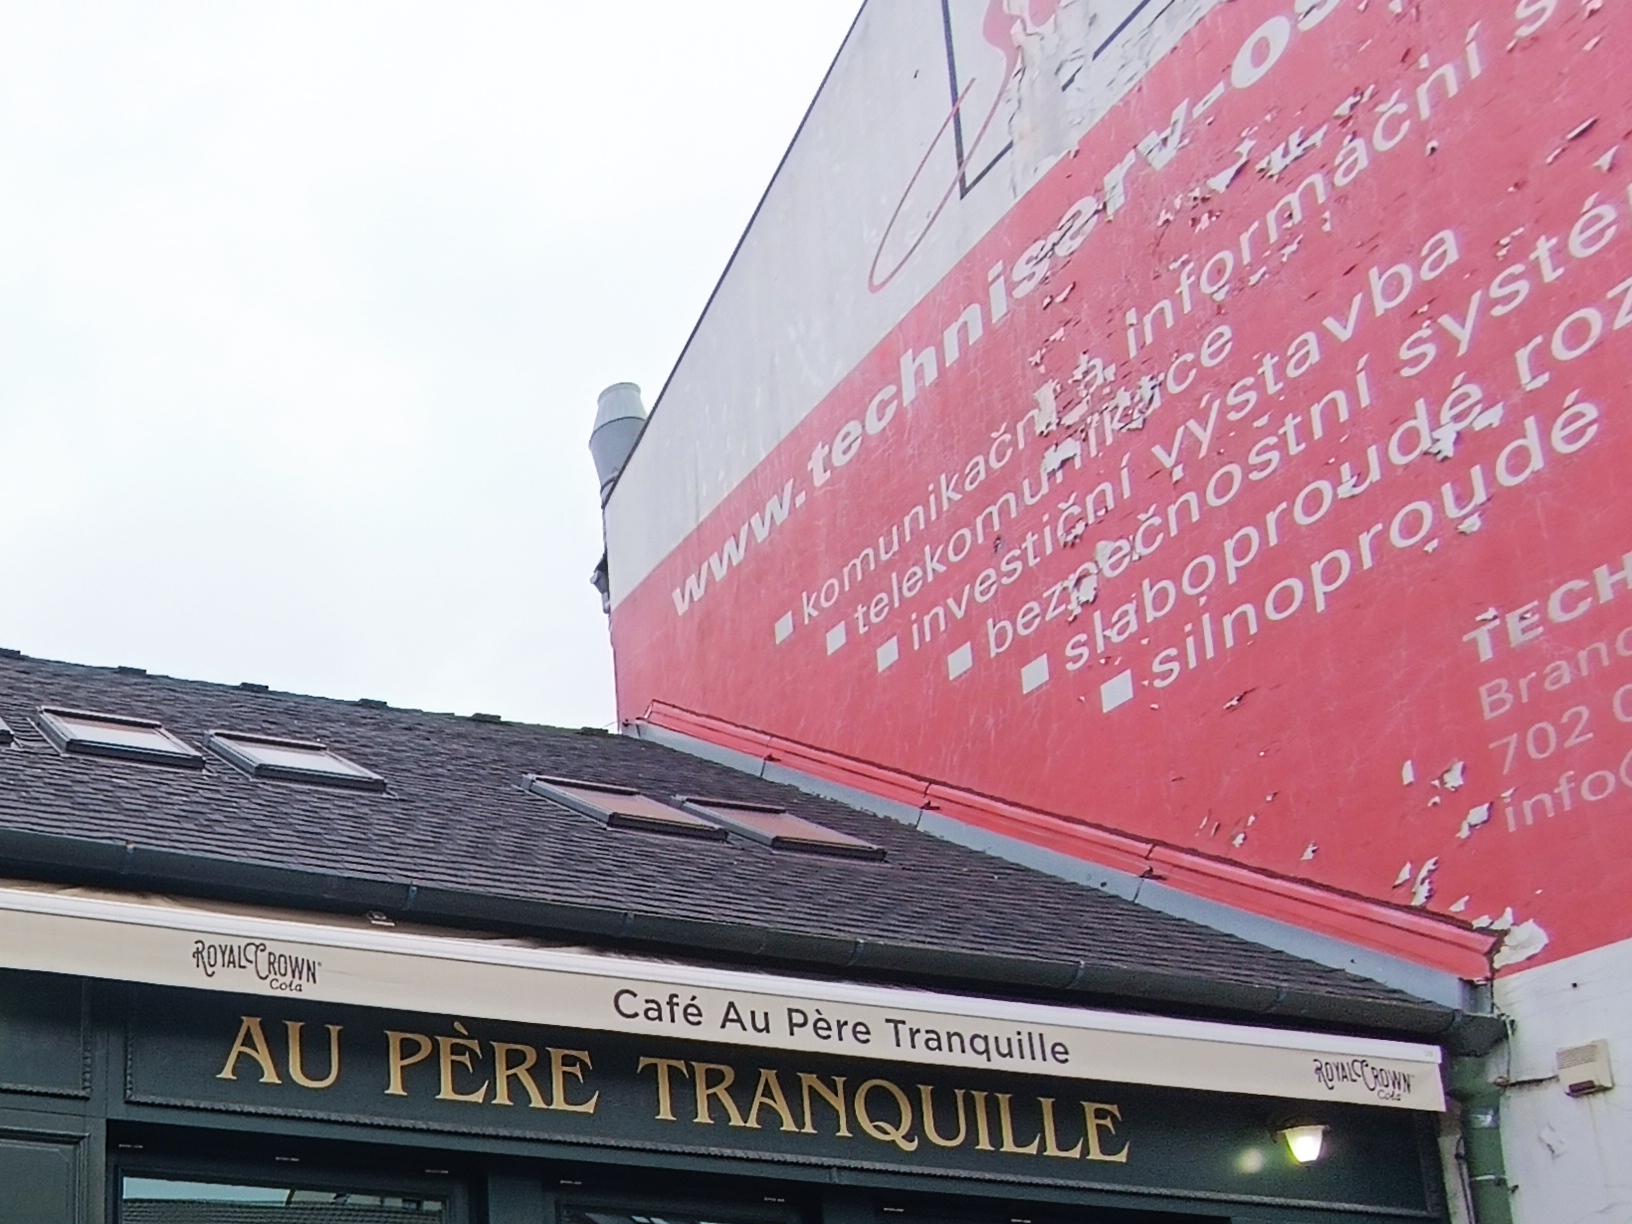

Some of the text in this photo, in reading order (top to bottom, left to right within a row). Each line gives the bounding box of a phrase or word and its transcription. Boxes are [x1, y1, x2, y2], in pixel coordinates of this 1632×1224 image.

[802, 380, 1058, 624] komunikačn
[1125, 20, 1481, 360] informační
[911, 229, 1460, 651] investiční výstavba
[986, 182, 1632, 657] bezpečnostní systé
[1065, 371, 1484, 672] slaboproudé
[1151, 388, 1599, 689] silnoproudé
[1488, 705, 1594, 776] 702
[1501, 748, 1632, 833] info
[243, 942, 317, 984] CROWN
[269, 978, 304, 993] Cola
[613, 988, 1071, 1065] Café Au Père Tranquille
[215, 1015, 1130, 1164] AU PÈRE TRANQUILLE
[1377, 1089, 1402, 1102] Cola
